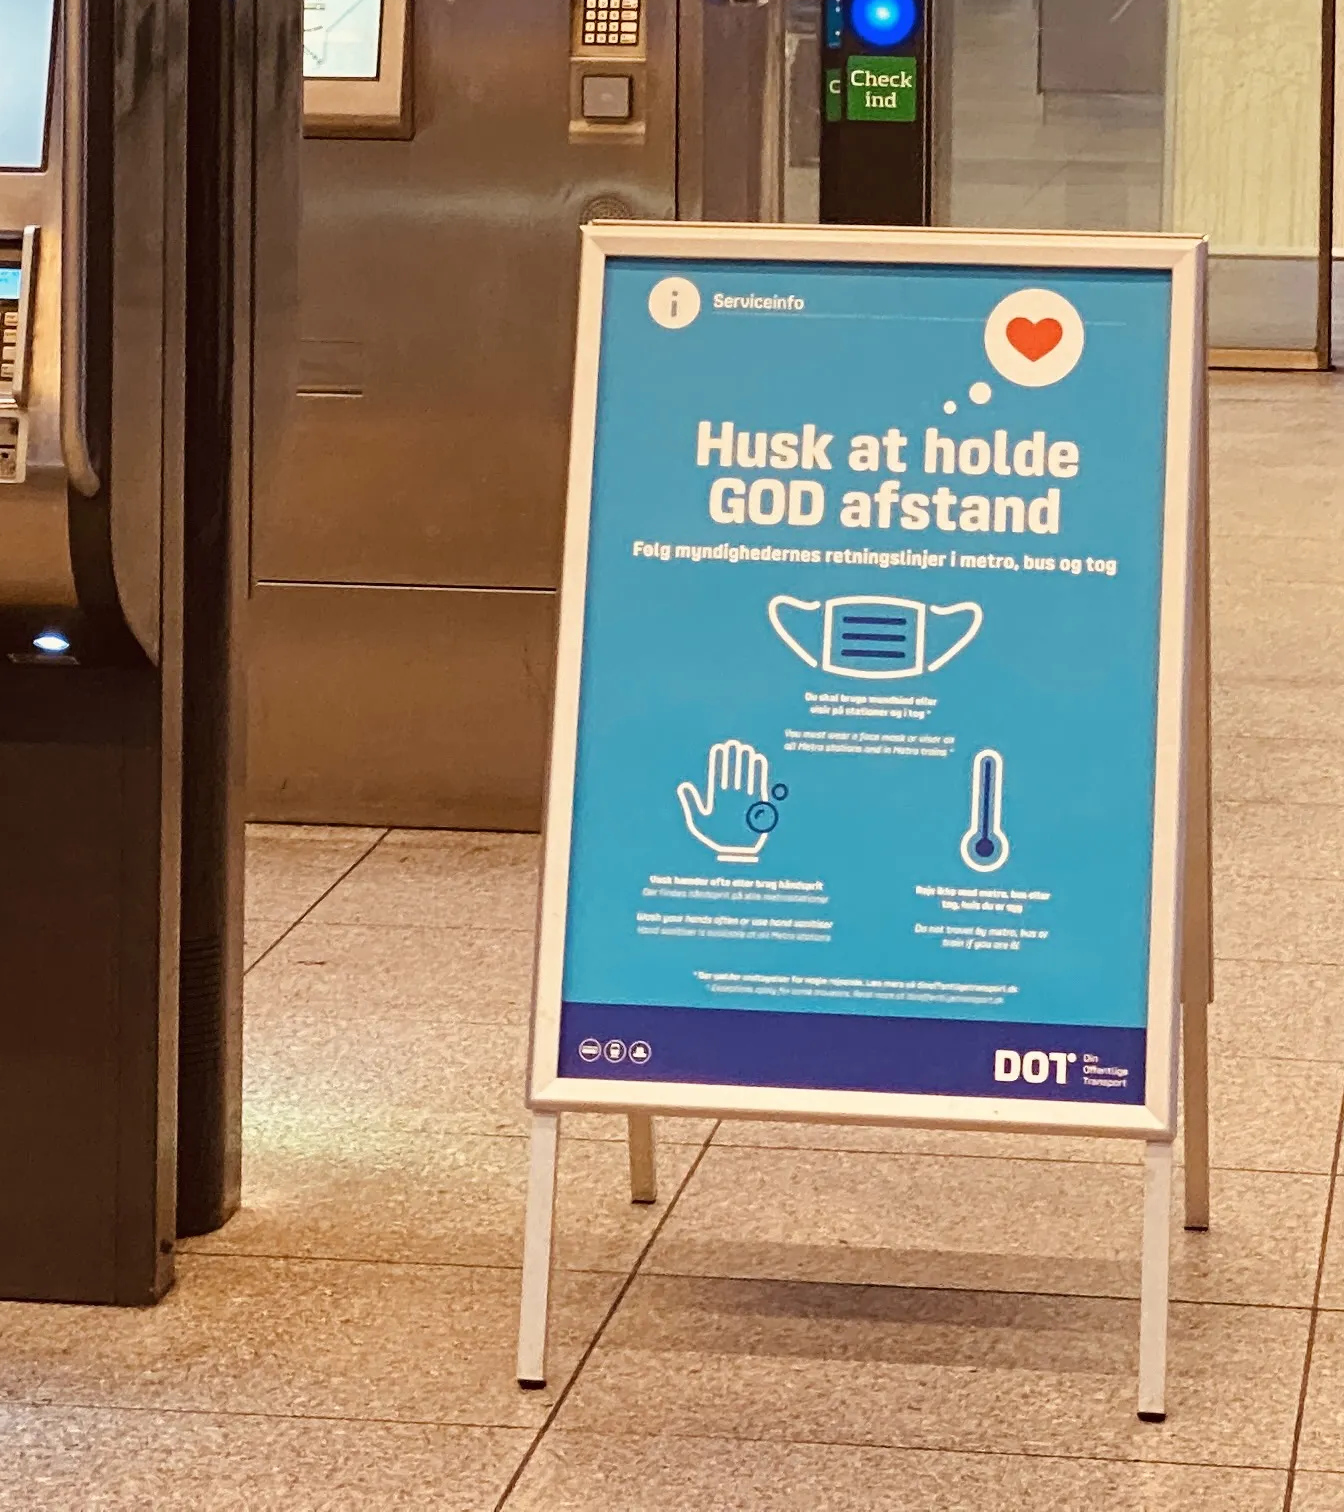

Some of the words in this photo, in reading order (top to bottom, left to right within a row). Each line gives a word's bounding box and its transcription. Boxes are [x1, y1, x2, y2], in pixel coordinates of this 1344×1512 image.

[850, 70, 912, 88] Check
[865, 91, 897, 108] ind
[713, 293, 805, 311] Serviceinfo
[697, 420, 832, 471] Husk
[849, 427, 907, 472] at
[924, 428, 1080, 478] holde
[709, 478, 825, 526] GOD
[840, 480, 1060, 534] afstand
[675, 544, 820, 566] myndighedernes
[826, 548, 946, 570] retningslinjer
[950, 550, 956, 568] i
[960, 552, 1019, 572] metro,
[1023, 554, 1055, 572] bus
[1060, 557, 1082, 575] og
[1086, 556, 1117, 577] tog
[994, 1049, 1077, 1084] DOT
